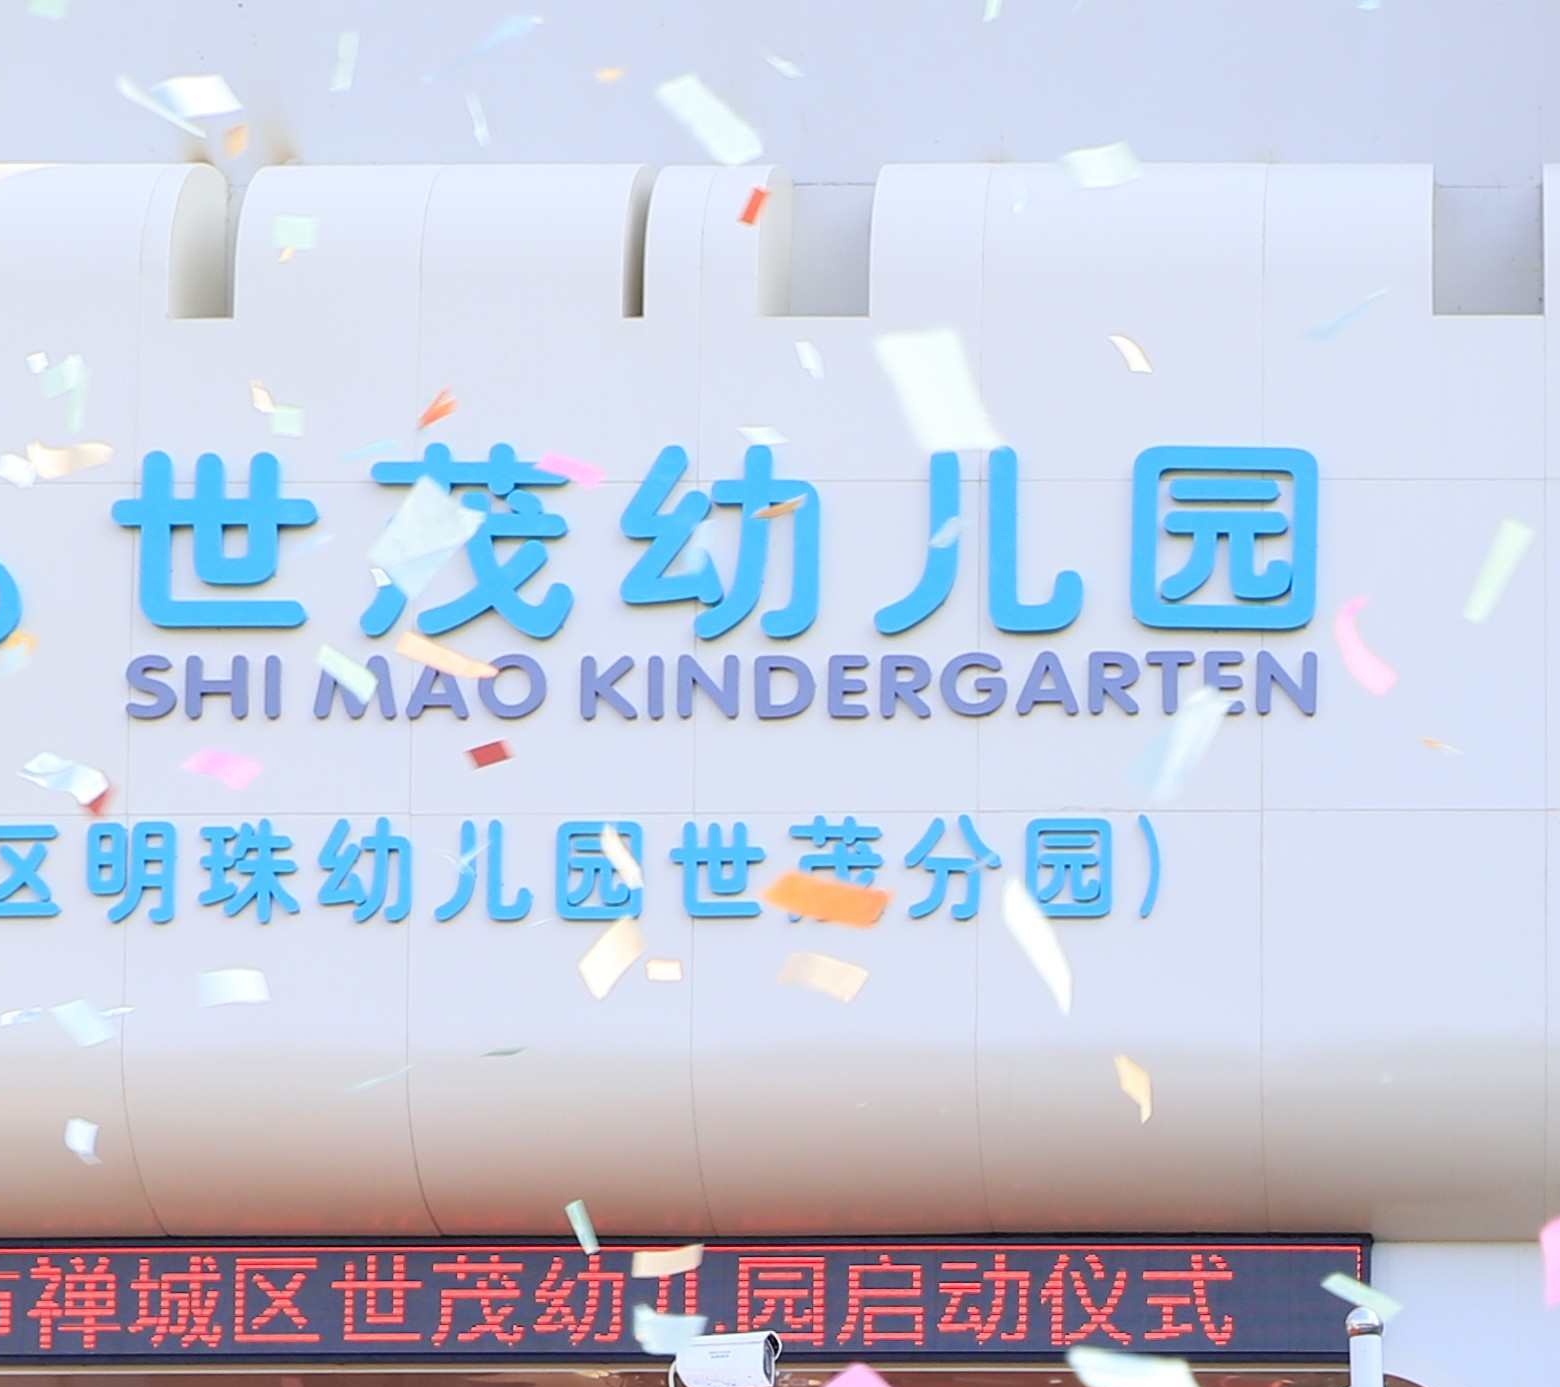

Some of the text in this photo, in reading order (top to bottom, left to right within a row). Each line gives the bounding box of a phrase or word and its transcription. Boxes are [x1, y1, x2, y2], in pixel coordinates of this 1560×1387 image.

[111, 442, 1320, 641] 世茂幼儿园
[124, 649, 1320, 719] SHI MAO KINDERGARTEN
